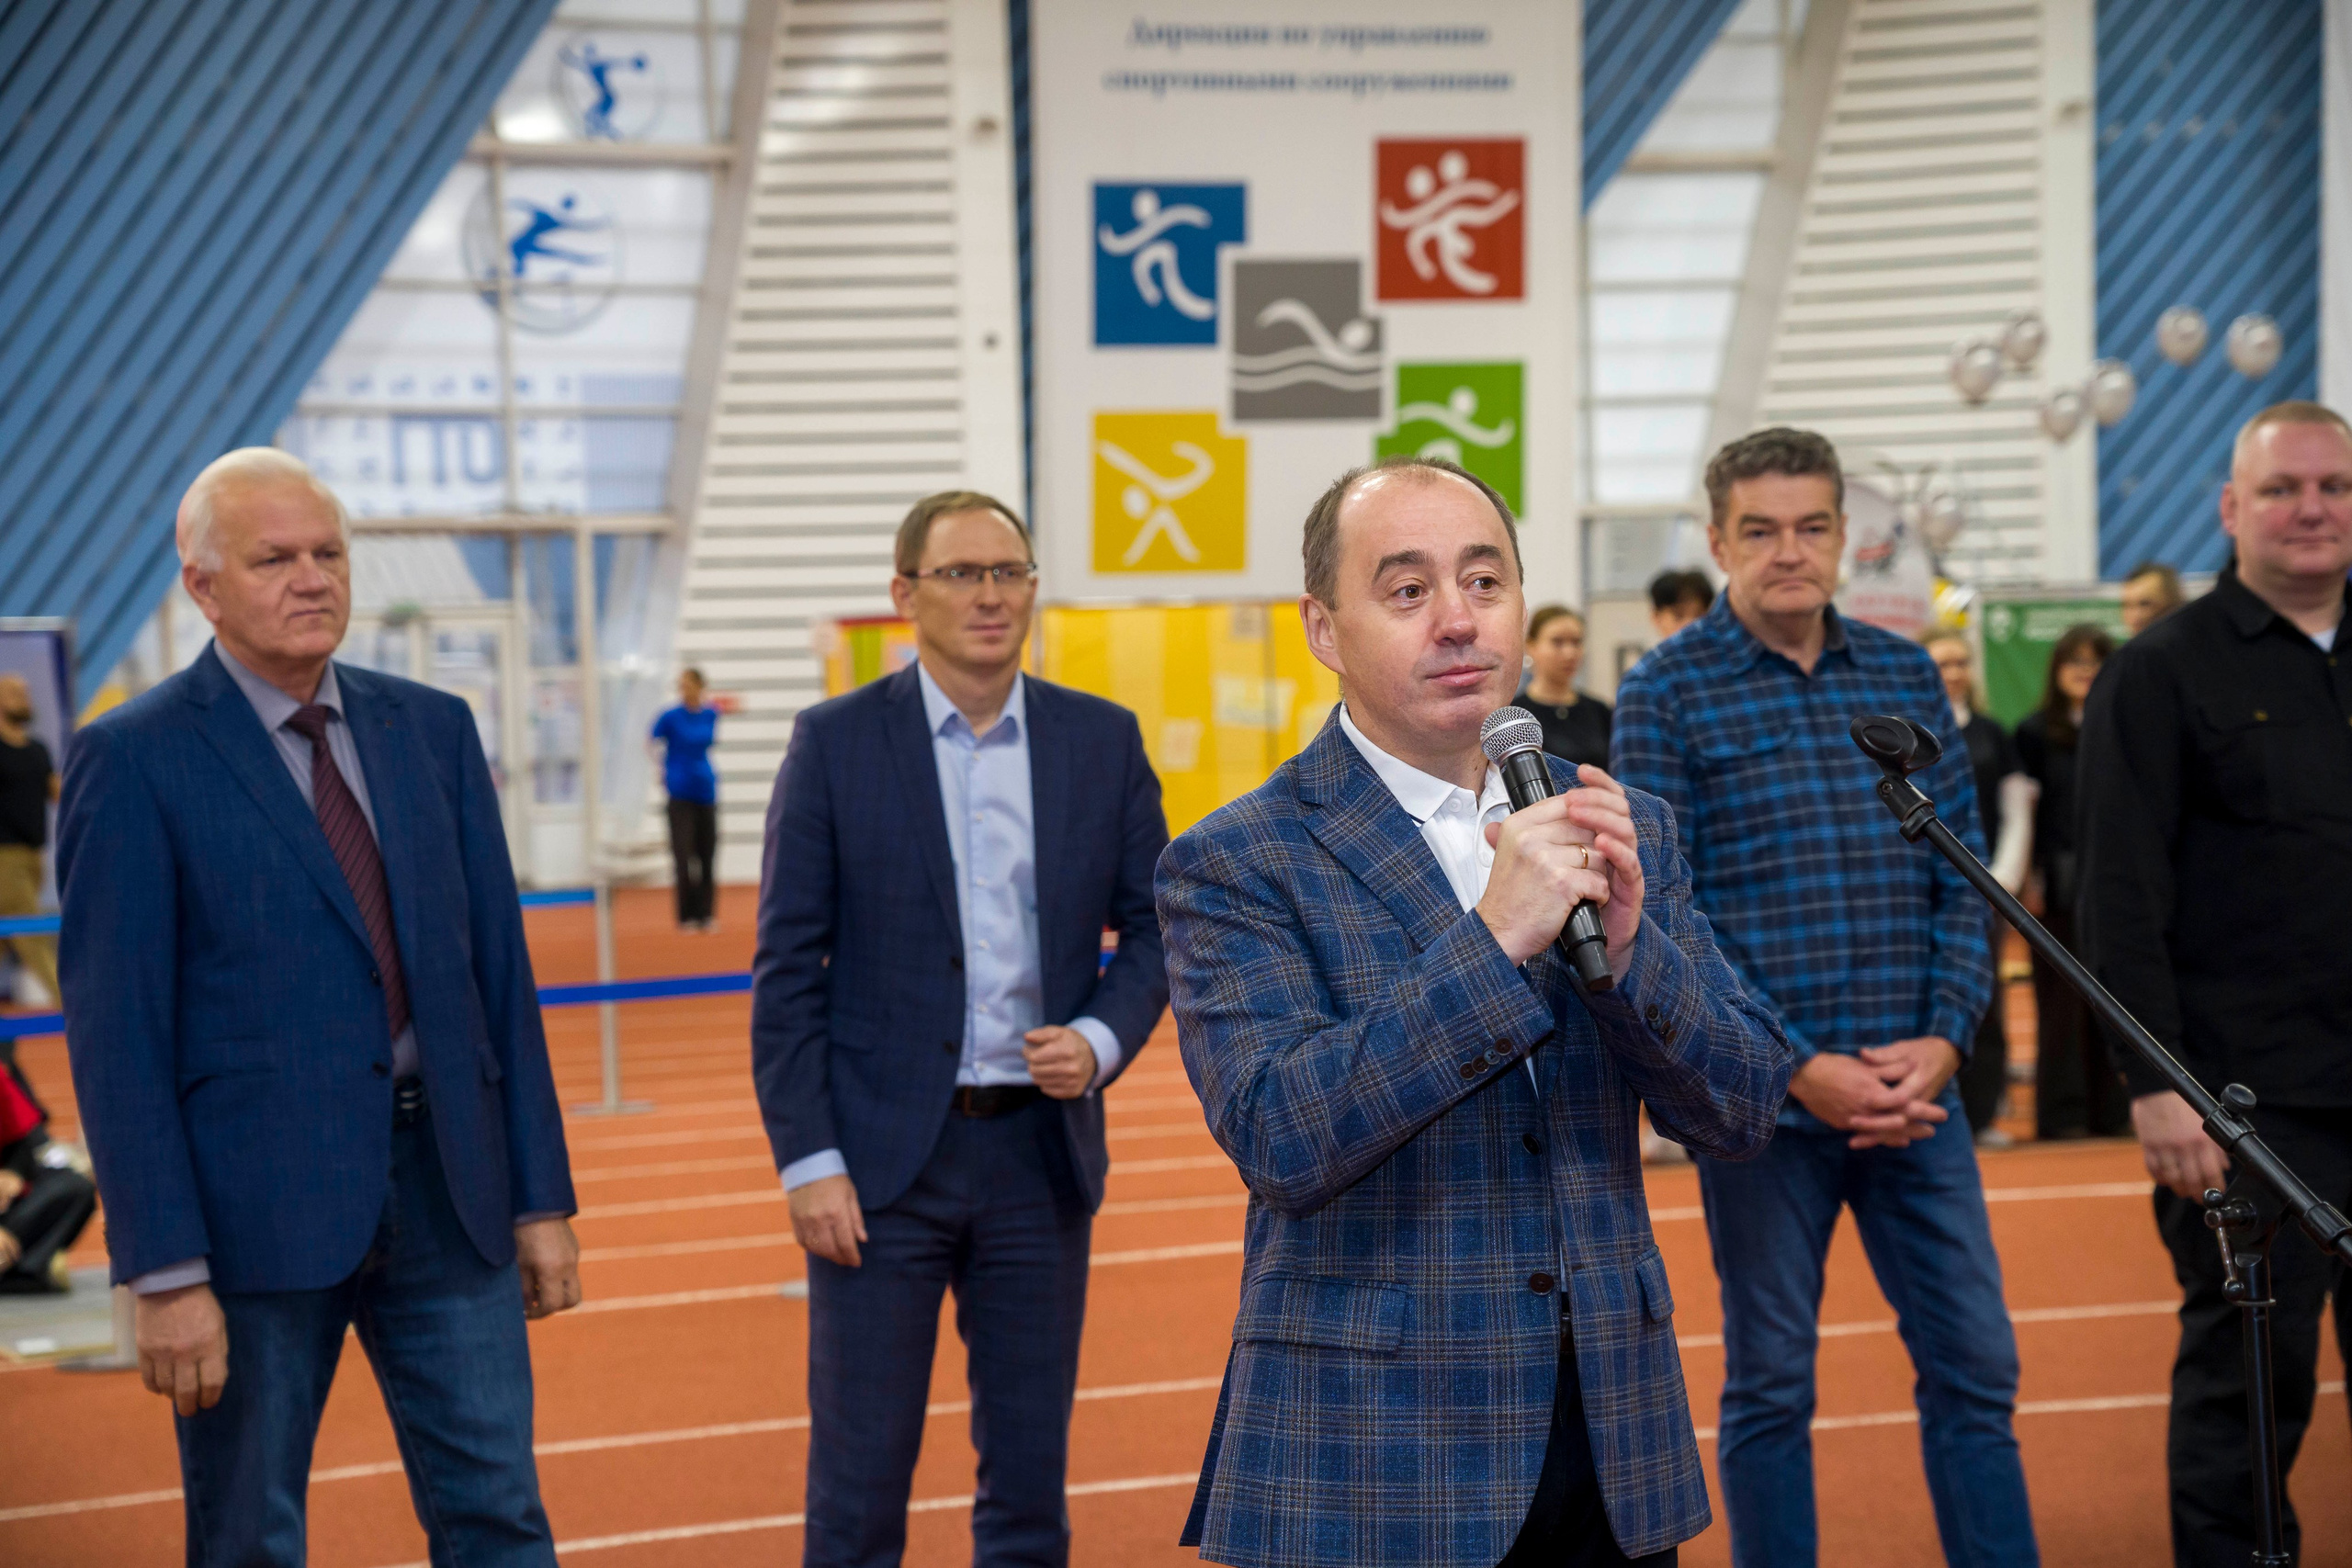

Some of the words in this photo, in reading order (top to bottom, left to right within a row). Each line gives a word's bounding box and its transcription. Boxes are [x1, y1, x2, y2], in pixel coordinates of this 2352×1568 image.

[1282, 24, 1310, 44] по
[1318, 23, 1488, 54] управлению
[1102, 70, 1296, 102] спортивными
[1308, 70, 1512, 102] сооружениями
